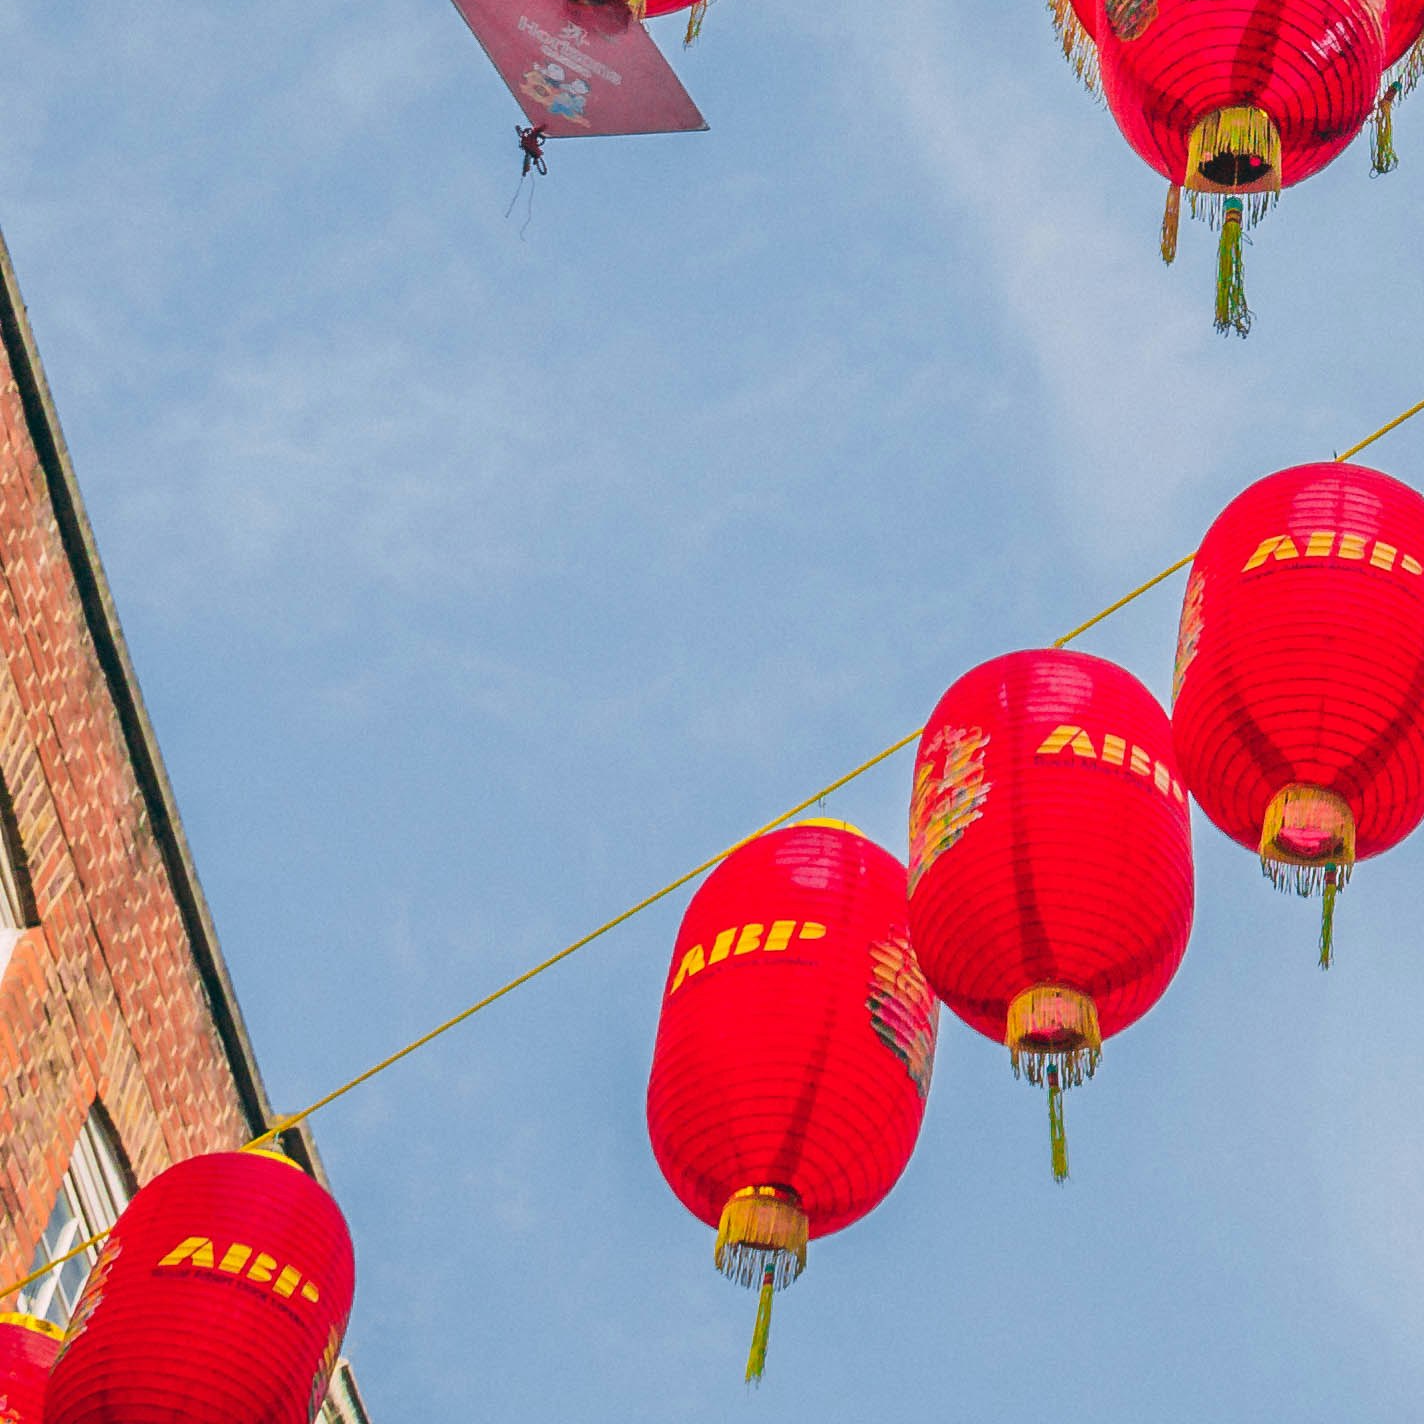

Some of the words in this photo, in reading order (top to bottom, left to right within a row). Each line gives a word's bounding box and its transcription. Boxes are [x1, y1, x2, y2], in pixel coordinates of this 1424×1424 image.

[1241, 531, 1424, 576] ABP
[1035, 724, 1185, 803] ABP
[671, 919, 828, 996] ABP
[157, 1236, 320, 1304] ABP
